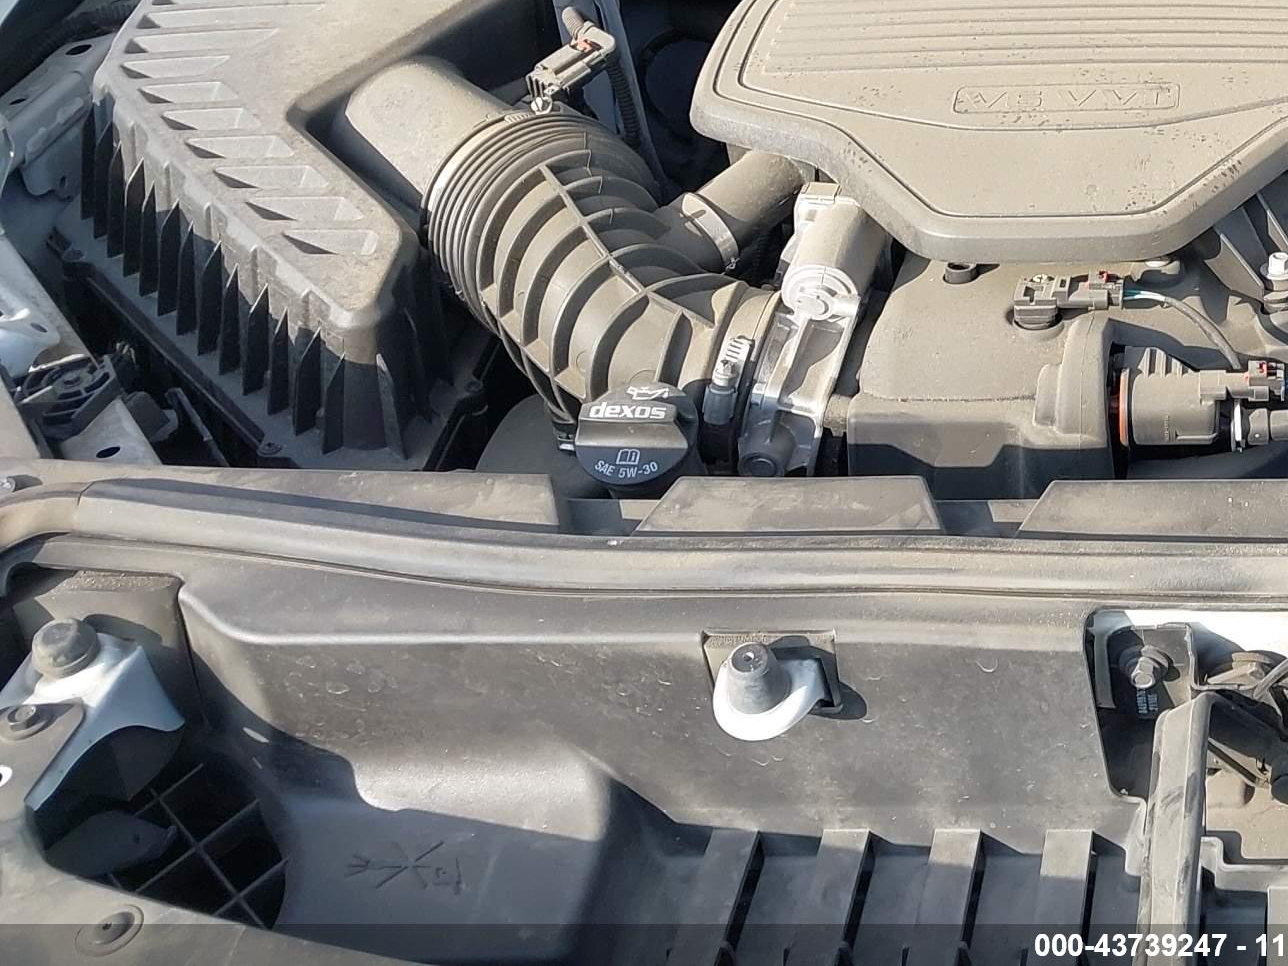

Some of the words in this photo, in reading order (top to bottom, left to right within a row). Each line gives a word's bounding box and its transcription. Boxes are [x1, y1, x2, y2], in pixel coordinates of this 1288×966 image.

[589, 401, 667, 420] dexos
[594, 460, 616, 477] SAE
[618, 461, 658, 478] 5W-30
